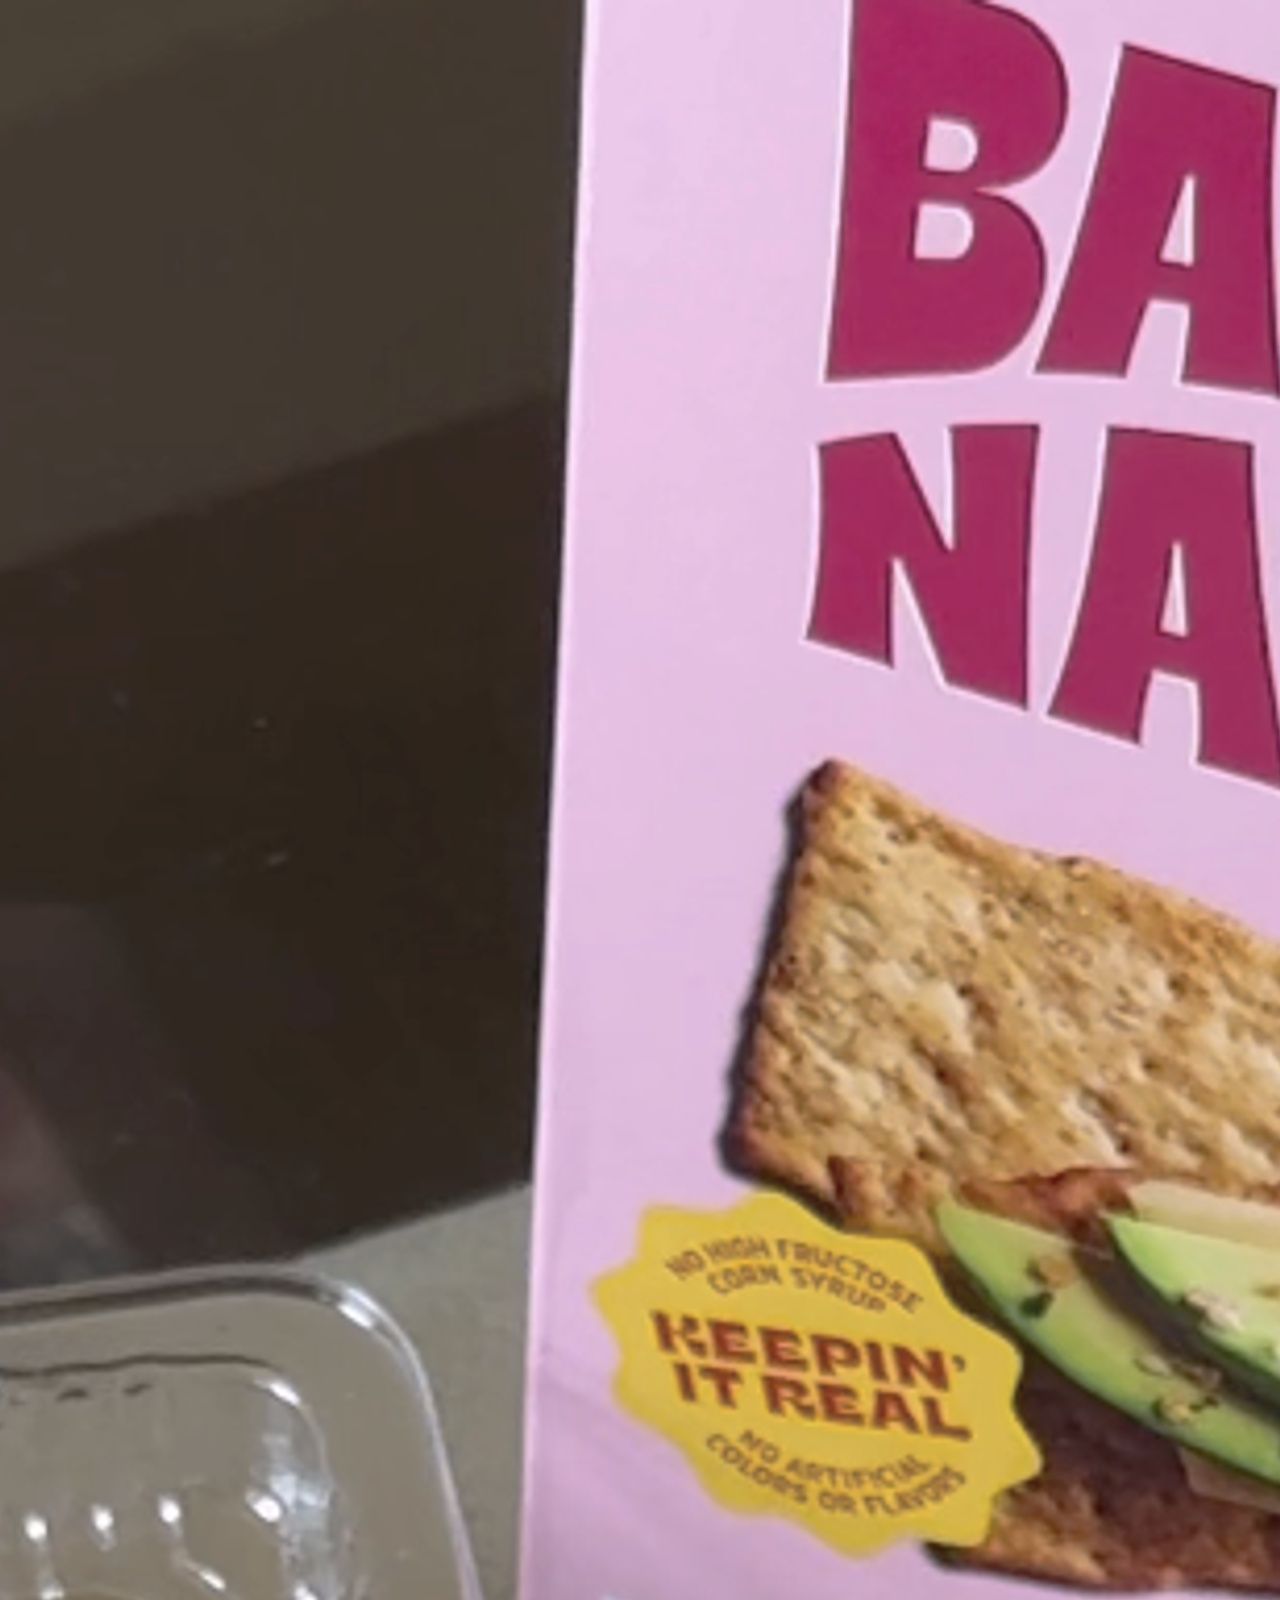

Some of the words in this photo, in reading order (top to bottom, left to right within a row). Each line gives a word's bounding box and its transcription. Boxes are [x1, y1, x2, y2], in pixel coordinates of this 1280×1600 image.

[666, 1249, 705, 1280] NO
[703, 1237, 771, 1264] HIGH
[776, 1238, 924, 1314] FRUCTOSE
[707, 1265, 783, 1295] CORN
[791, 1267, 886, 1313] SYRUP
[673, 1362, 743, 1409] IT
[761, 1375, 972, 1441] REAL
[705, 1433, 808, 1505] COLORS
[819, 1491, 858, 1515] OR
[864, 1465, 967, 1516] FLAVORS
[738, 1429, 780, 1464] NO
[786, 1454, 932, 1490] ARTIFICIAL
